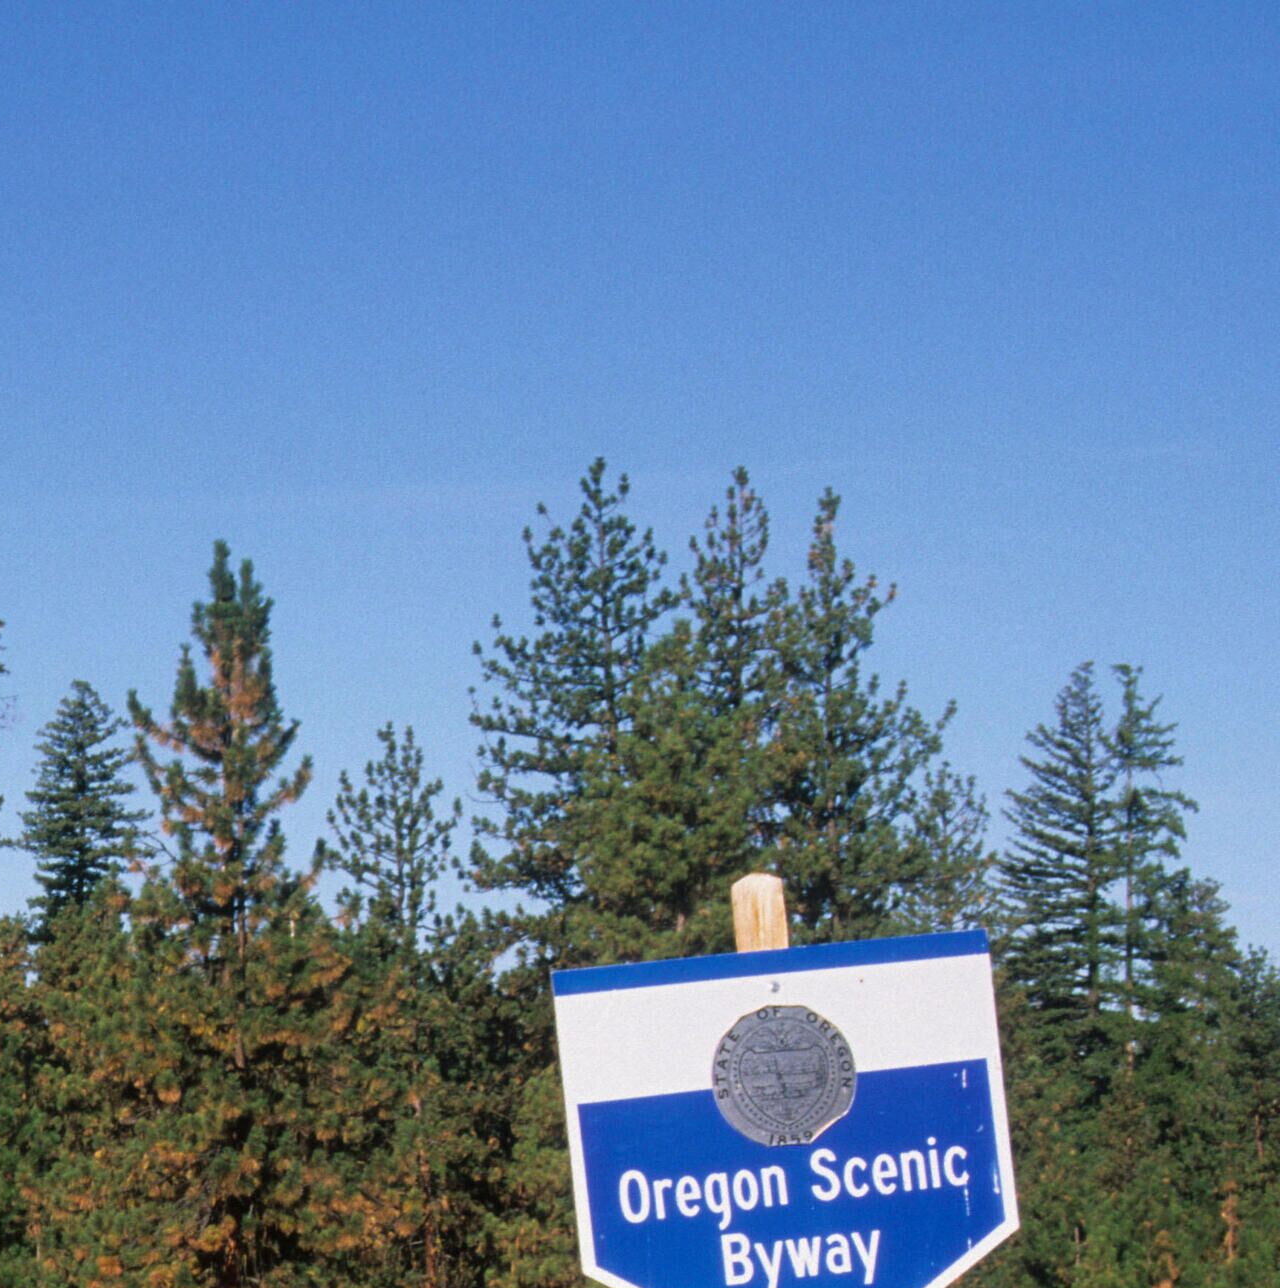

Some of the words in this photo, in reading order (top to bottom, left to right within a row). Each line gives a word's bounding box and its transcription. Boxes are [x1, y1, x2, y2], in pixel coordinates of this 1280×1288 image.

[715, 1033, 740, 1100] STATE
[756, 1007, 781, 1020] OF
[806, 1012, 852, 1088] OREGON
[618, 1163, 789, 1231] Oregon
[810, 1136, 969, 1203] Scenic
[769, 1131, 813, 1146] 1859
